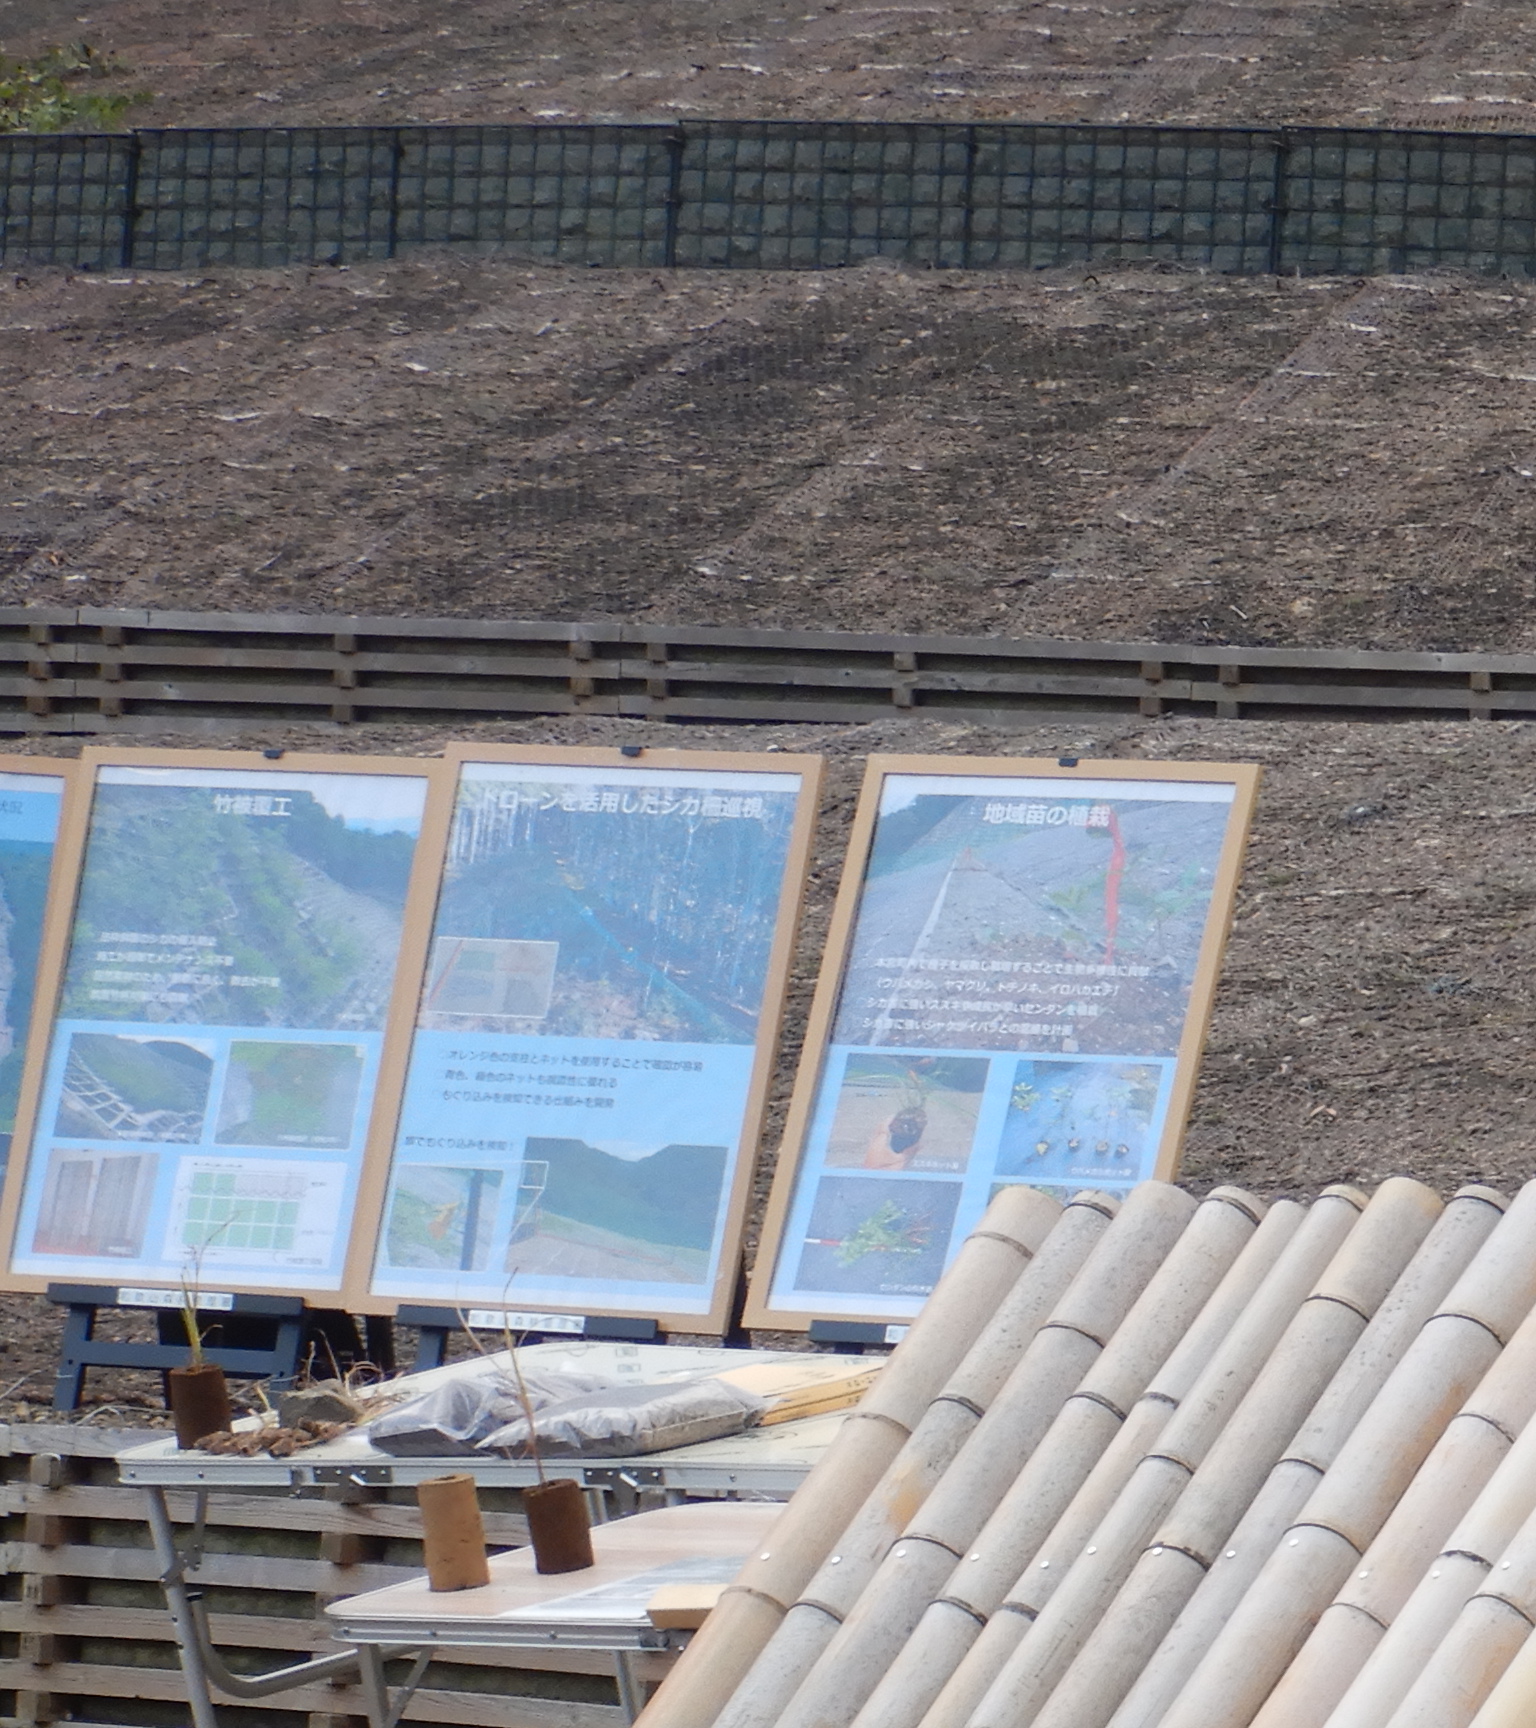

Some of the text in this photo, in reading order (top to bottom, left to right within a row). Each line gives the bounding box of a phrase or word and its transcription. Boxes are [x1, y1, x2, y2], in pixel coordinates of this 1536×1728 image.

[982, 803, 1111, 827] 地域苗の植栽
